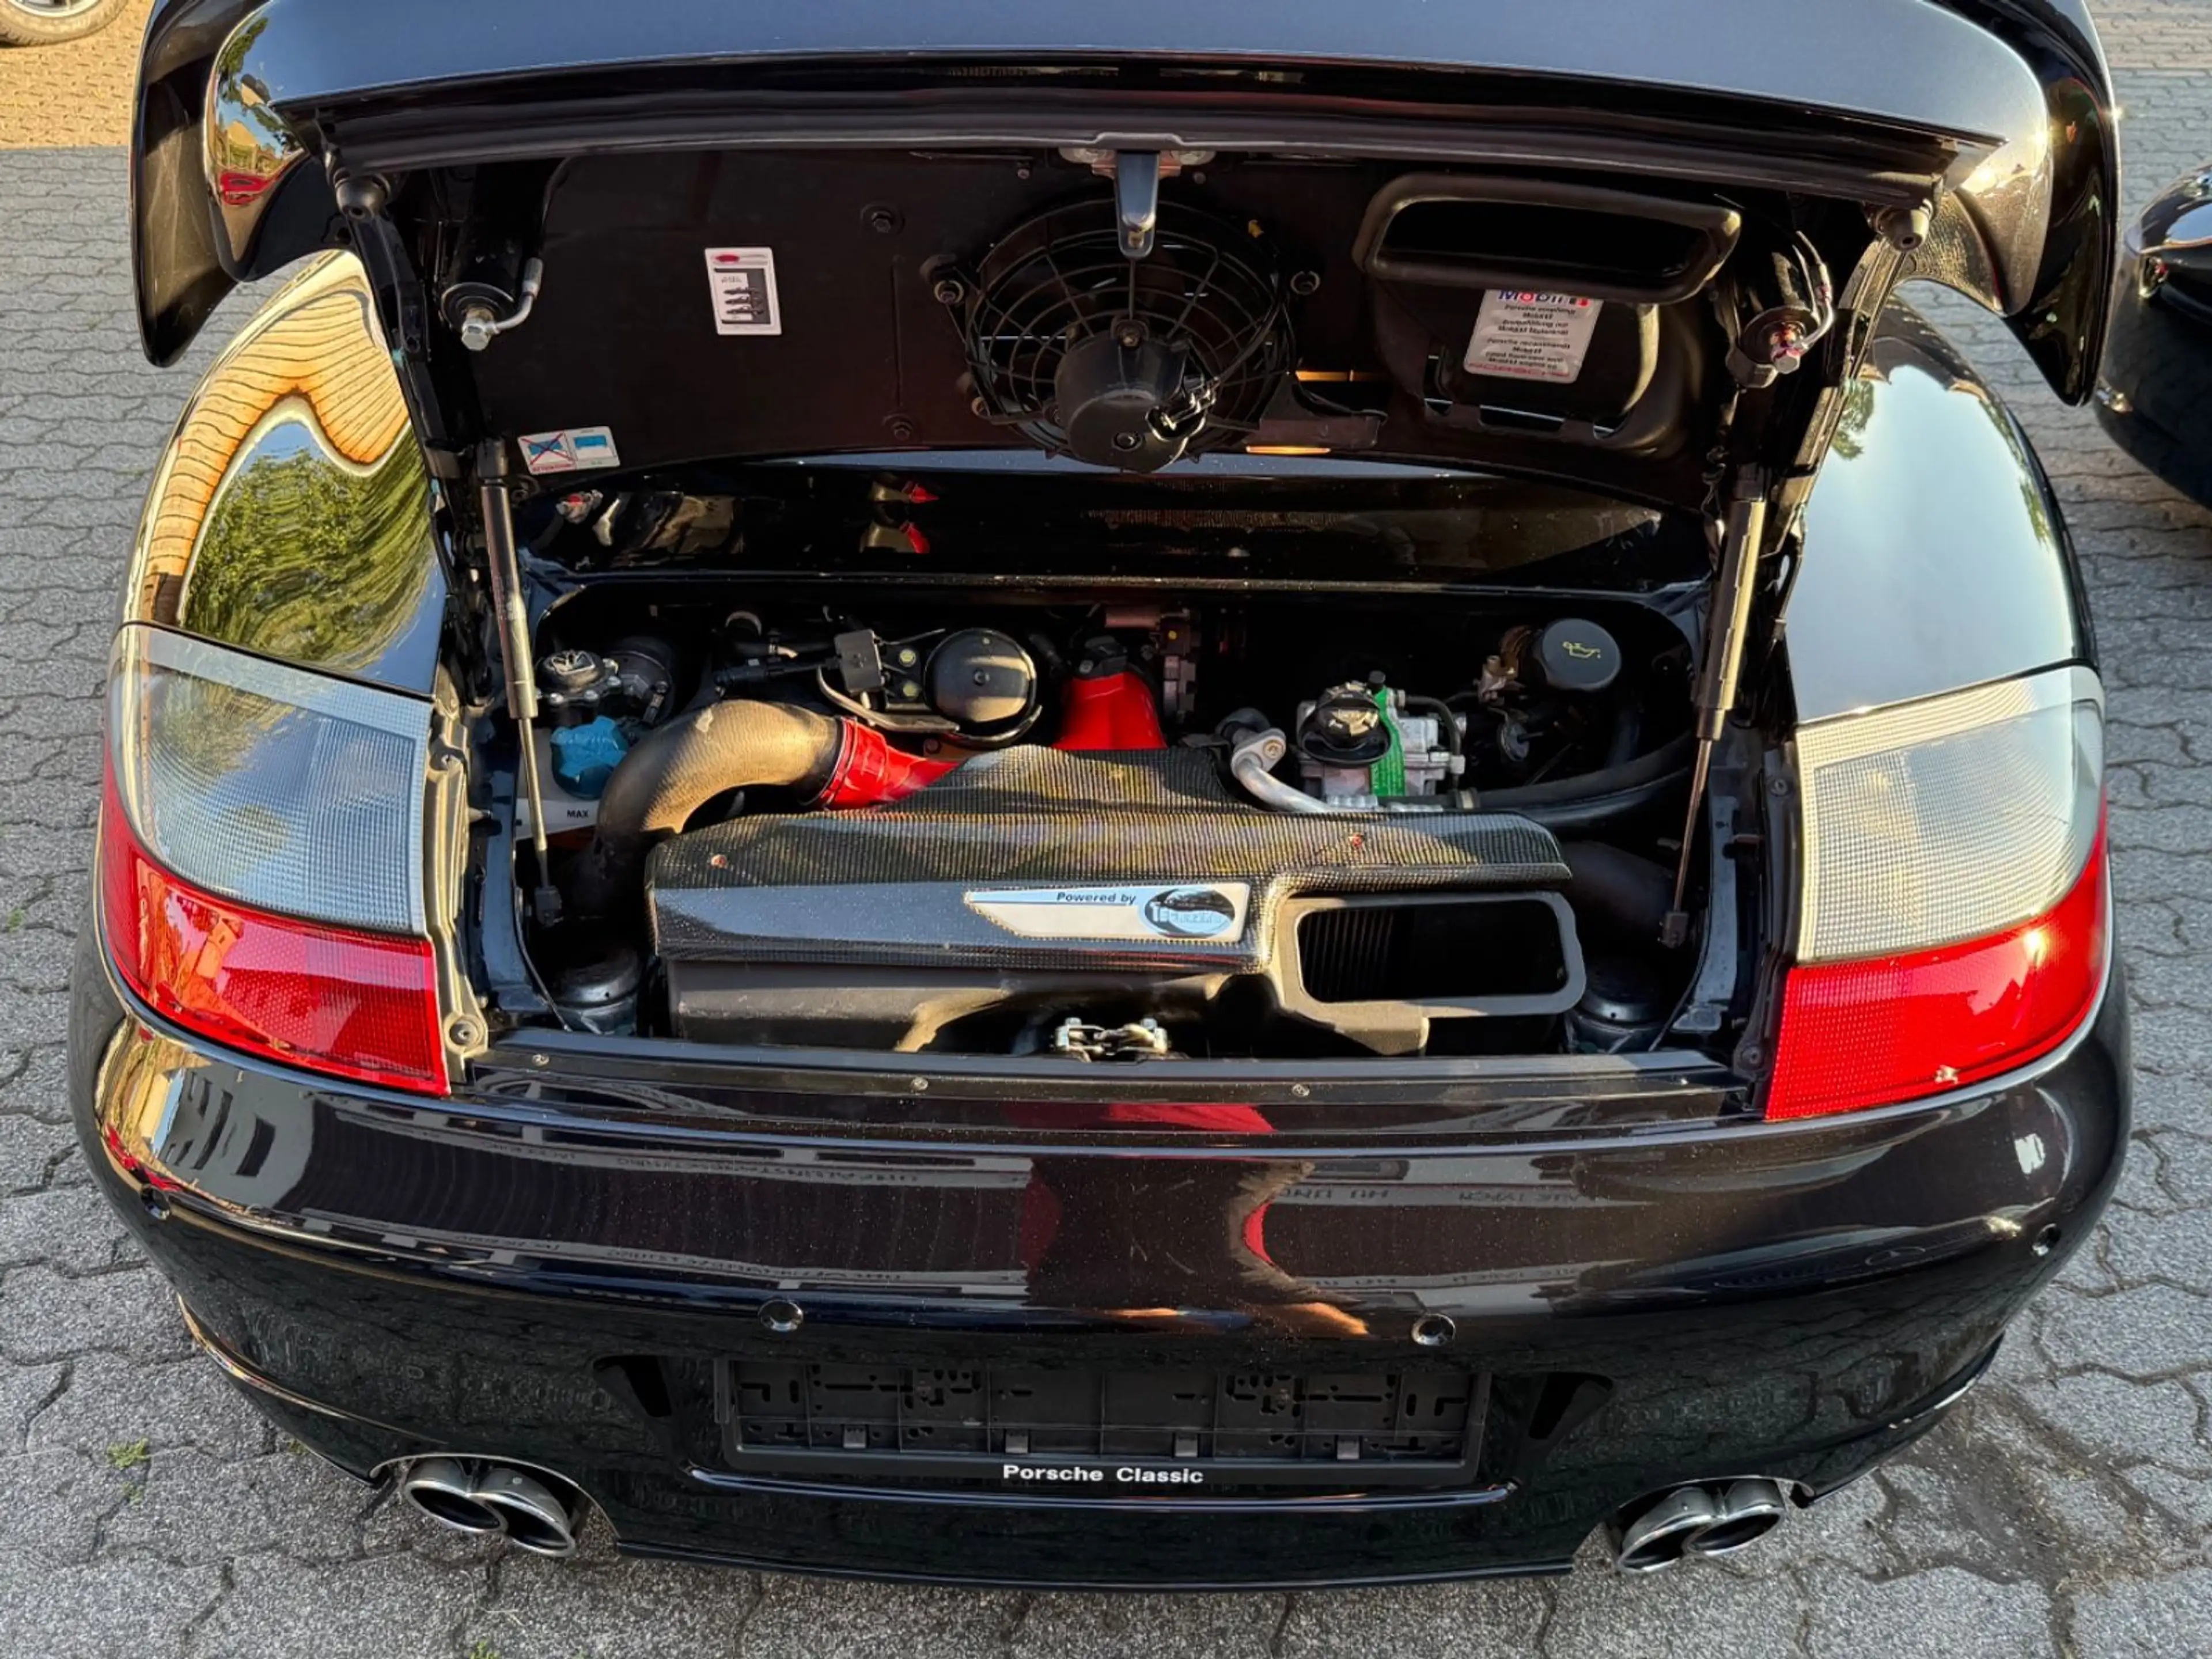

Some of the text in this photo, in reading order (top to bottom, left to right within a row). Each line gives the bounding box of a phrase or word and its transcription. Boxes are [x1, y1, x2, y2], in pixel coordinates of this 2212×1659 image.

[567, 810, 589, 818] MAX
[1056, 892, 1137, 906] Powered by
[1003, 1464, 1204, 1483] Porsche Classic
